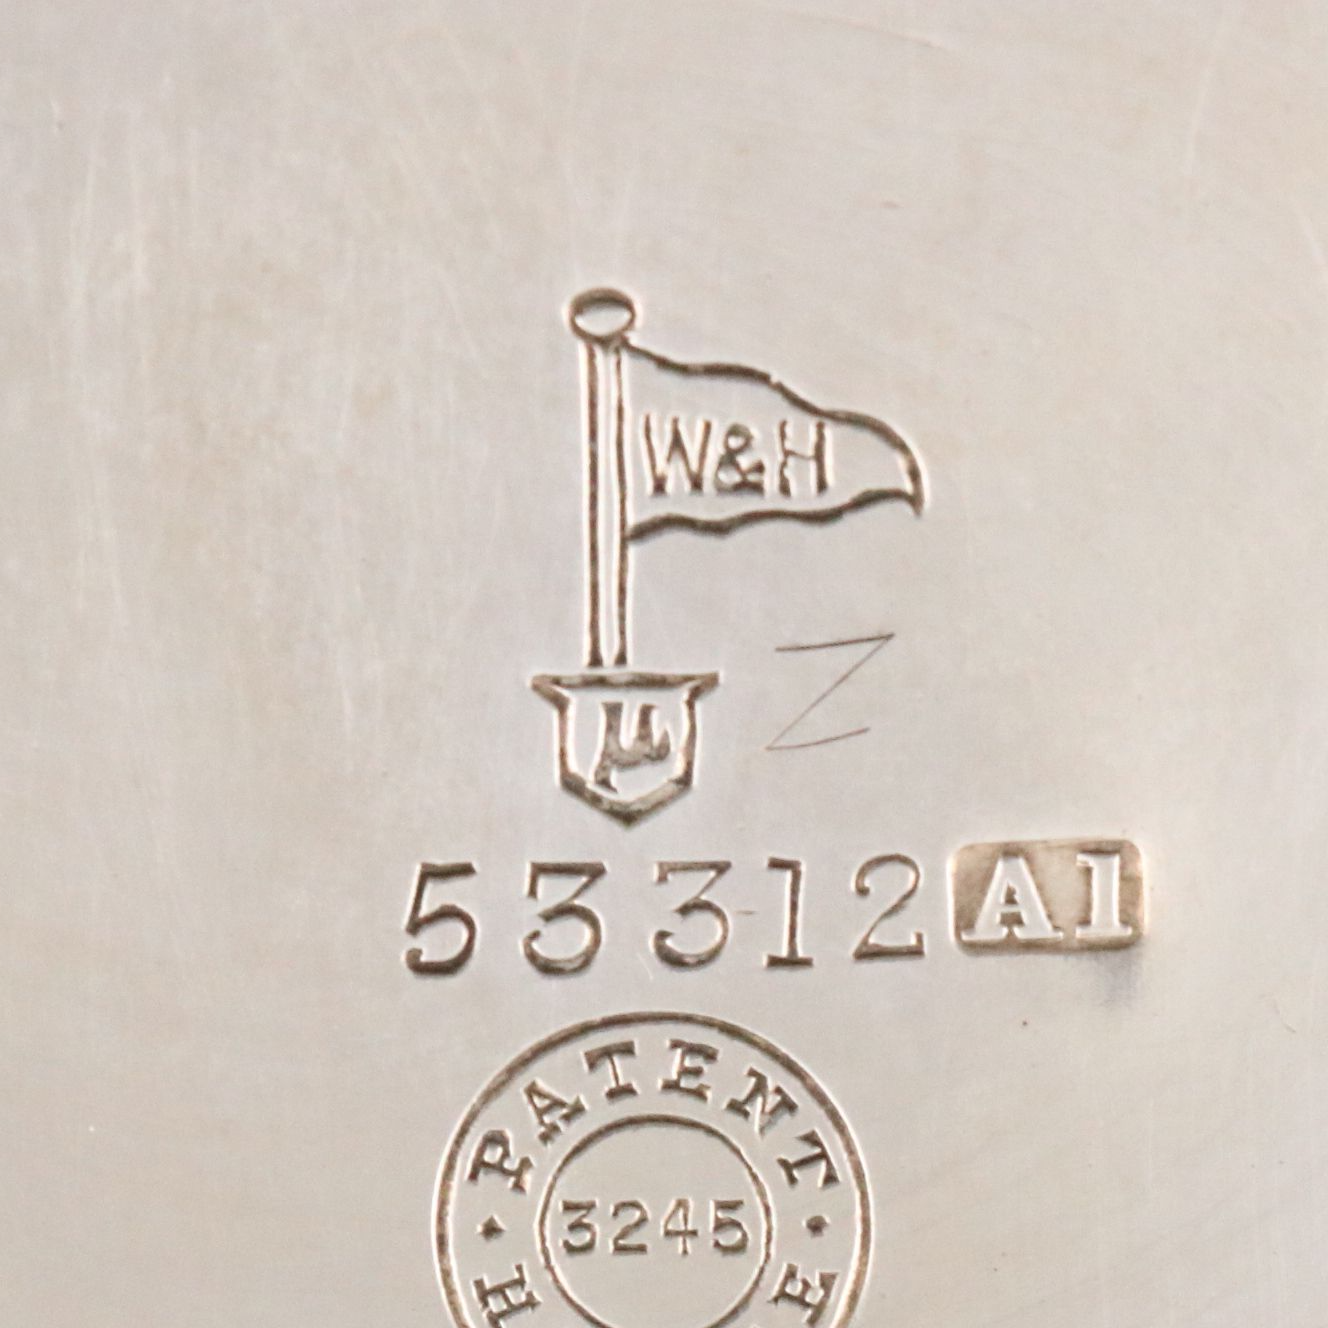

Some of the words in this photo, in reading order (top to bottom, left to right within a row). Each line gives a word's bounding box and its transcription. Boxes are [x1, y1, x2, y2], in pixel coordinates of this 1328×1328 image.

[644, 412, 830, 496] W&H
[403, 853, 926, 976] 53312
[960, 851, 1133, 941] A1
[468, 1040, 840, 1194] PATENT
[561, 1199, 749, 1255] 3245
